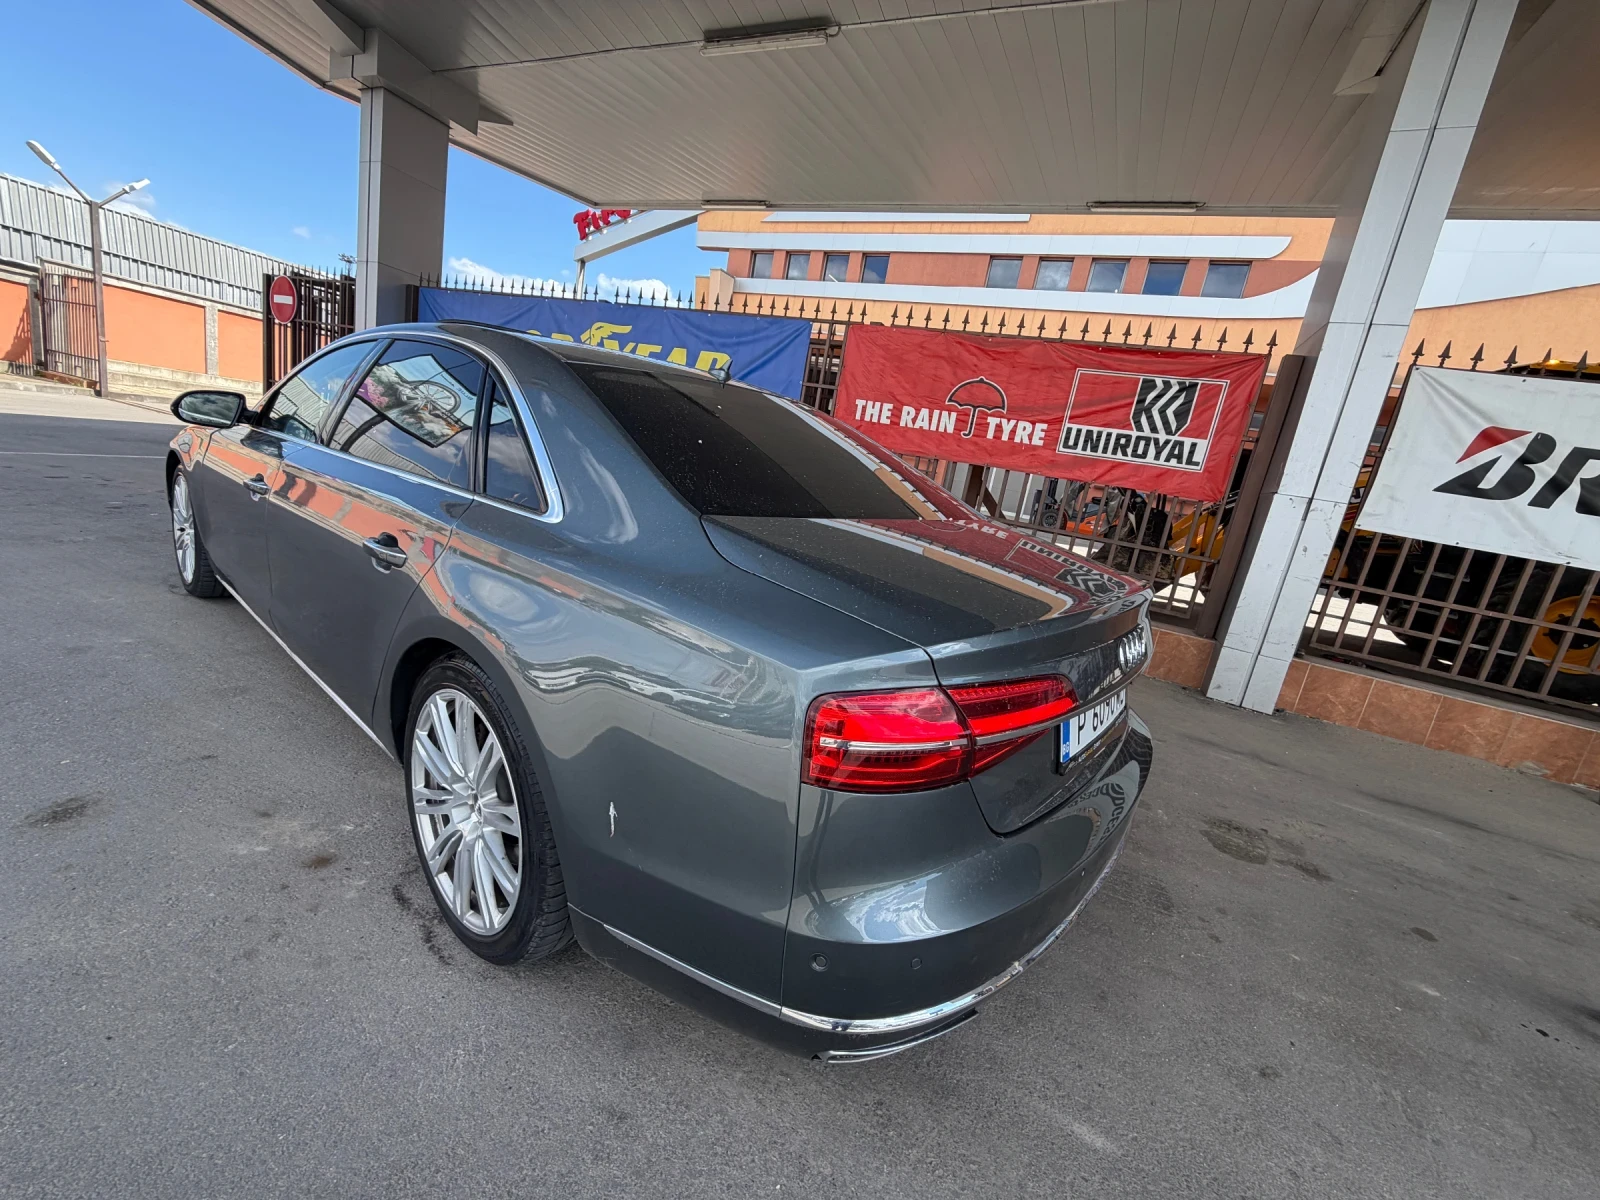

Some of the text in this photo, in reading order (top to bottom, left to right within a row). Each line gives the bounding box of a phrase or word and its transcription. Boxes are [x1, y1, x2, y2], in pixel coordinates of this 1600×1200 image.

[854, 399, 1048, 446] THE RAIN TYRE
[1062, 427, 1203, 467] UNIROYAL
[1078, 712, 1086, 745] P
[1063, 742, 1070, 755] BG
